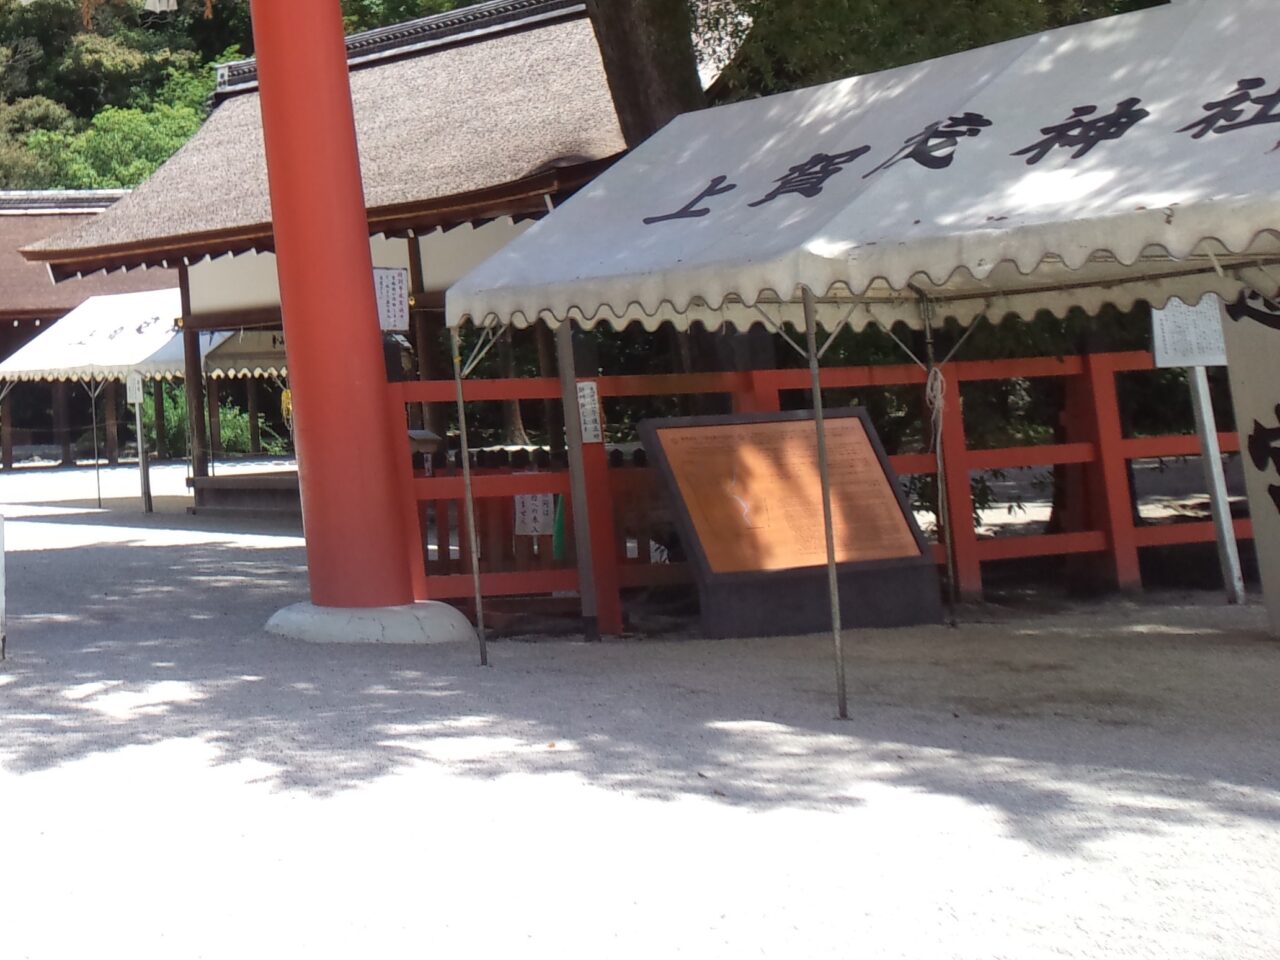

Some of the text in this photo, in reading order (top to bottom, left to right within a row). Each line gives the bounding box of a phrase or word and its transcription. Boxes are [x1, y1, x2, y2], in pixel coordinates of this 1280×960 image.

[643, 77, 1280, 225] 上賀茂神社
